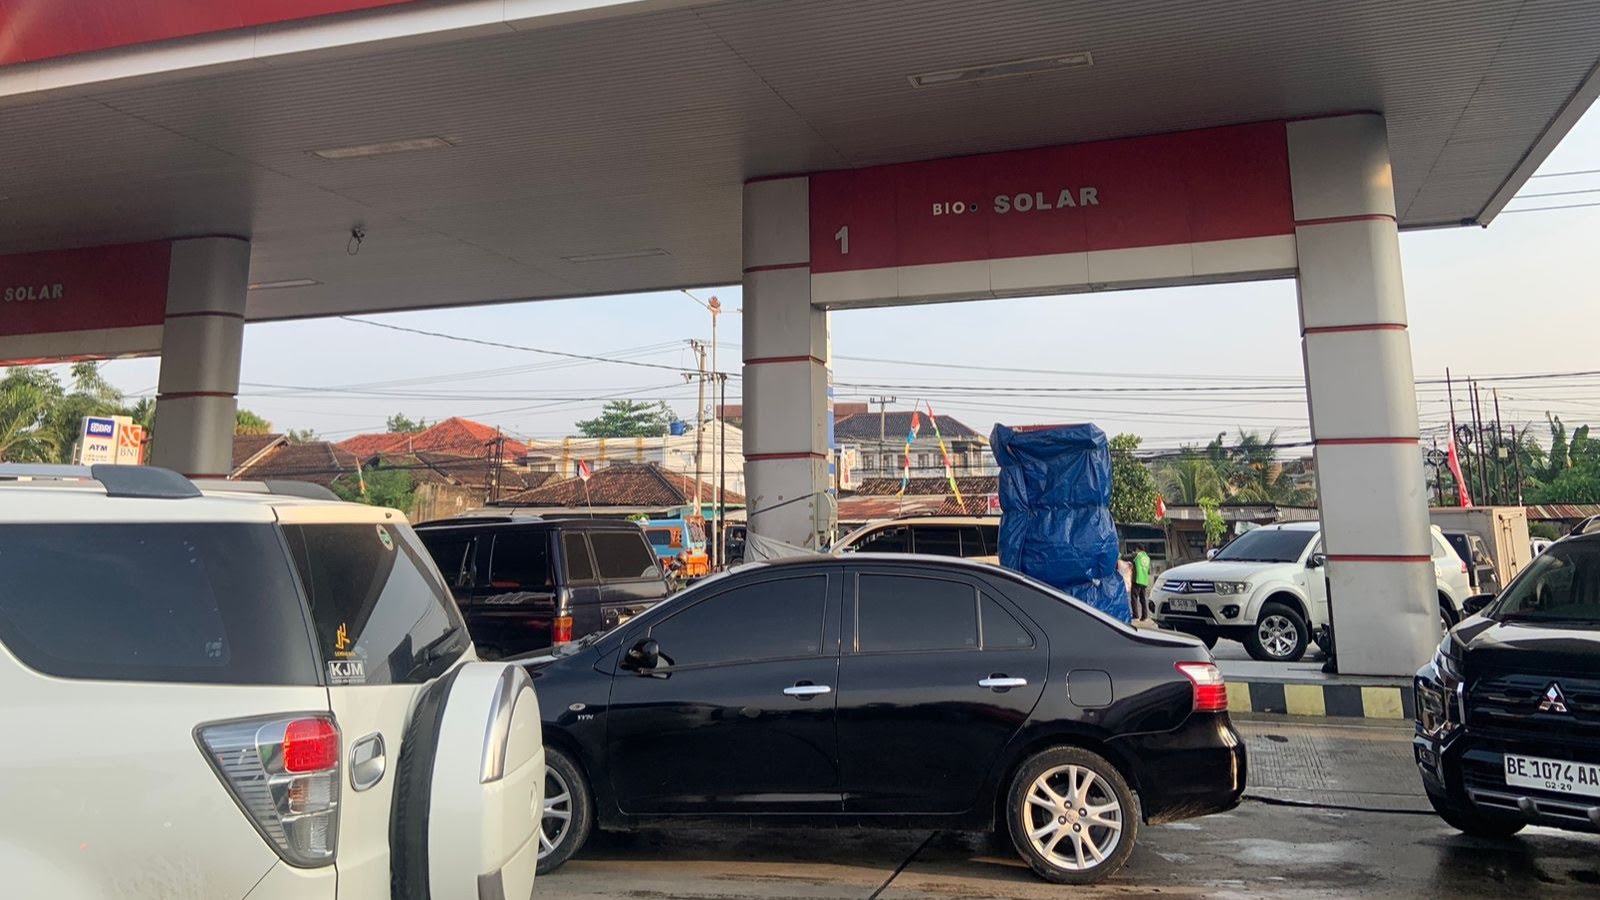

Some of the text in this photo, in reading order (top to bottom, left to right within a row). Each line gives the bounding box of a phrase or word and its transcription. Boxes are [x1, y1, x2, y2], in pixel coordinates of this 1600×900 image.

[933, 187, 1099, 216] BIO SOLAR
[834, 225, 849, 254] 1
[4, 283, 64, 302] SOLAR
[89, 444, 108, 452] ATM
[120, 448, 138, 457] BNI
[331, 662, 364, 676] KJM
[1506, 756, 1600, 786] BE 1074 AA
